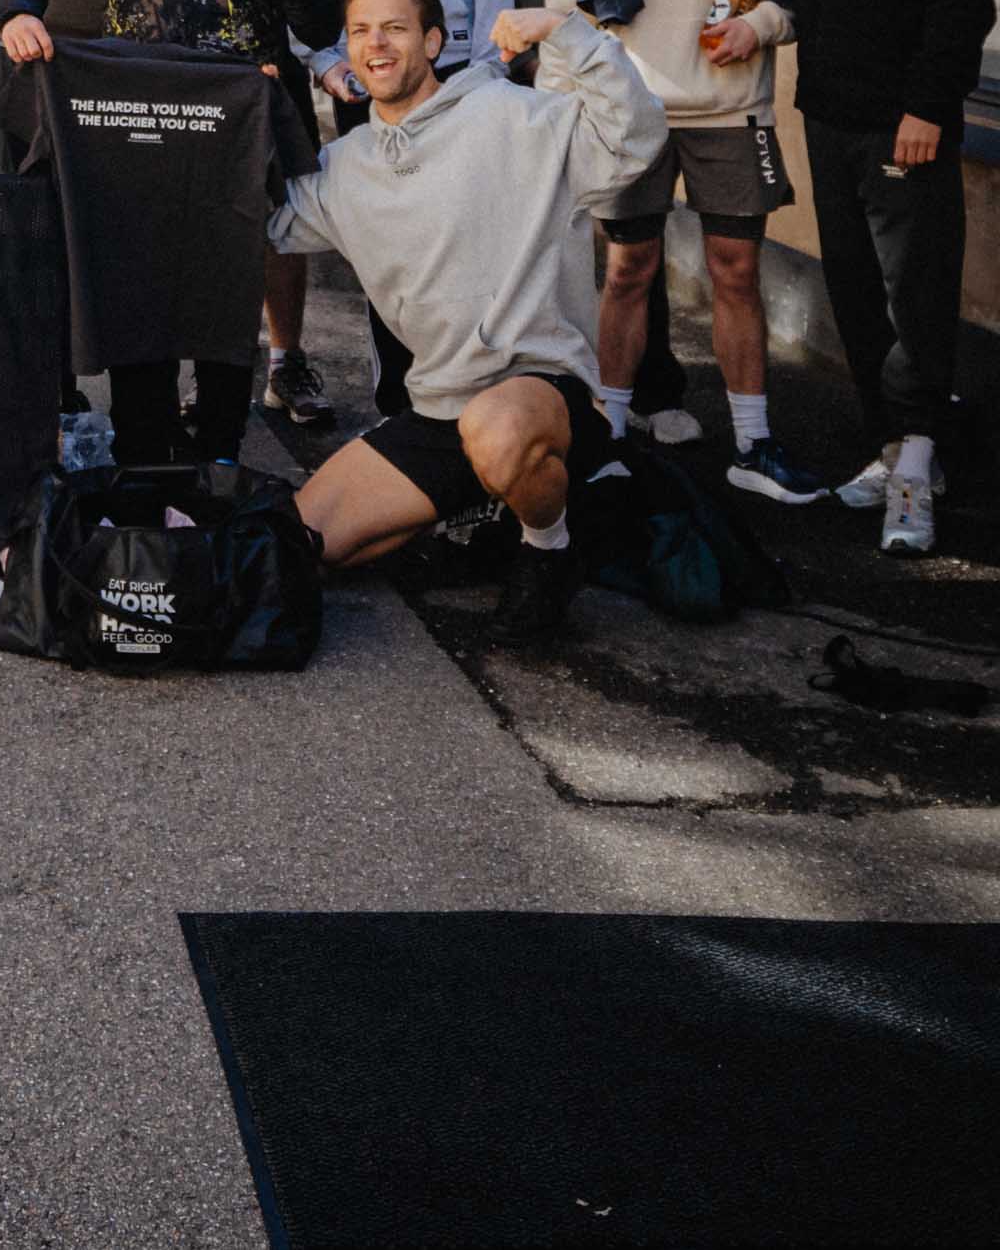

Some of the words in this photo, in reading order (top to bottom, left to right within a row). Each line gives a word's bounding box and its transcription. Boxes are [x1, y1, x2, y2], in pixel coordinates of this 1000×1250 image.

[70, 99, 95, 112] THE
[97, 101, 149, 115] HARDER
[151, 103, 179, 116] YOU
[181, 105, 226, 121] WORK,
[77, 114, 101, 126] THE
[103, 116, 157, 129] LUCKIER
[158, 118, 186, 131] YOU
[188, 120, 217, 133] GET.
[756, 130, 776, 184] HALO
[108, 578, 126, 590] EAT
[129, 581, 166, 593] RIGHT
[101, 590, 176, 613] WORK
[102, 632, 131, 643] FEEL
[135, 634, 173, 644] GOOD
